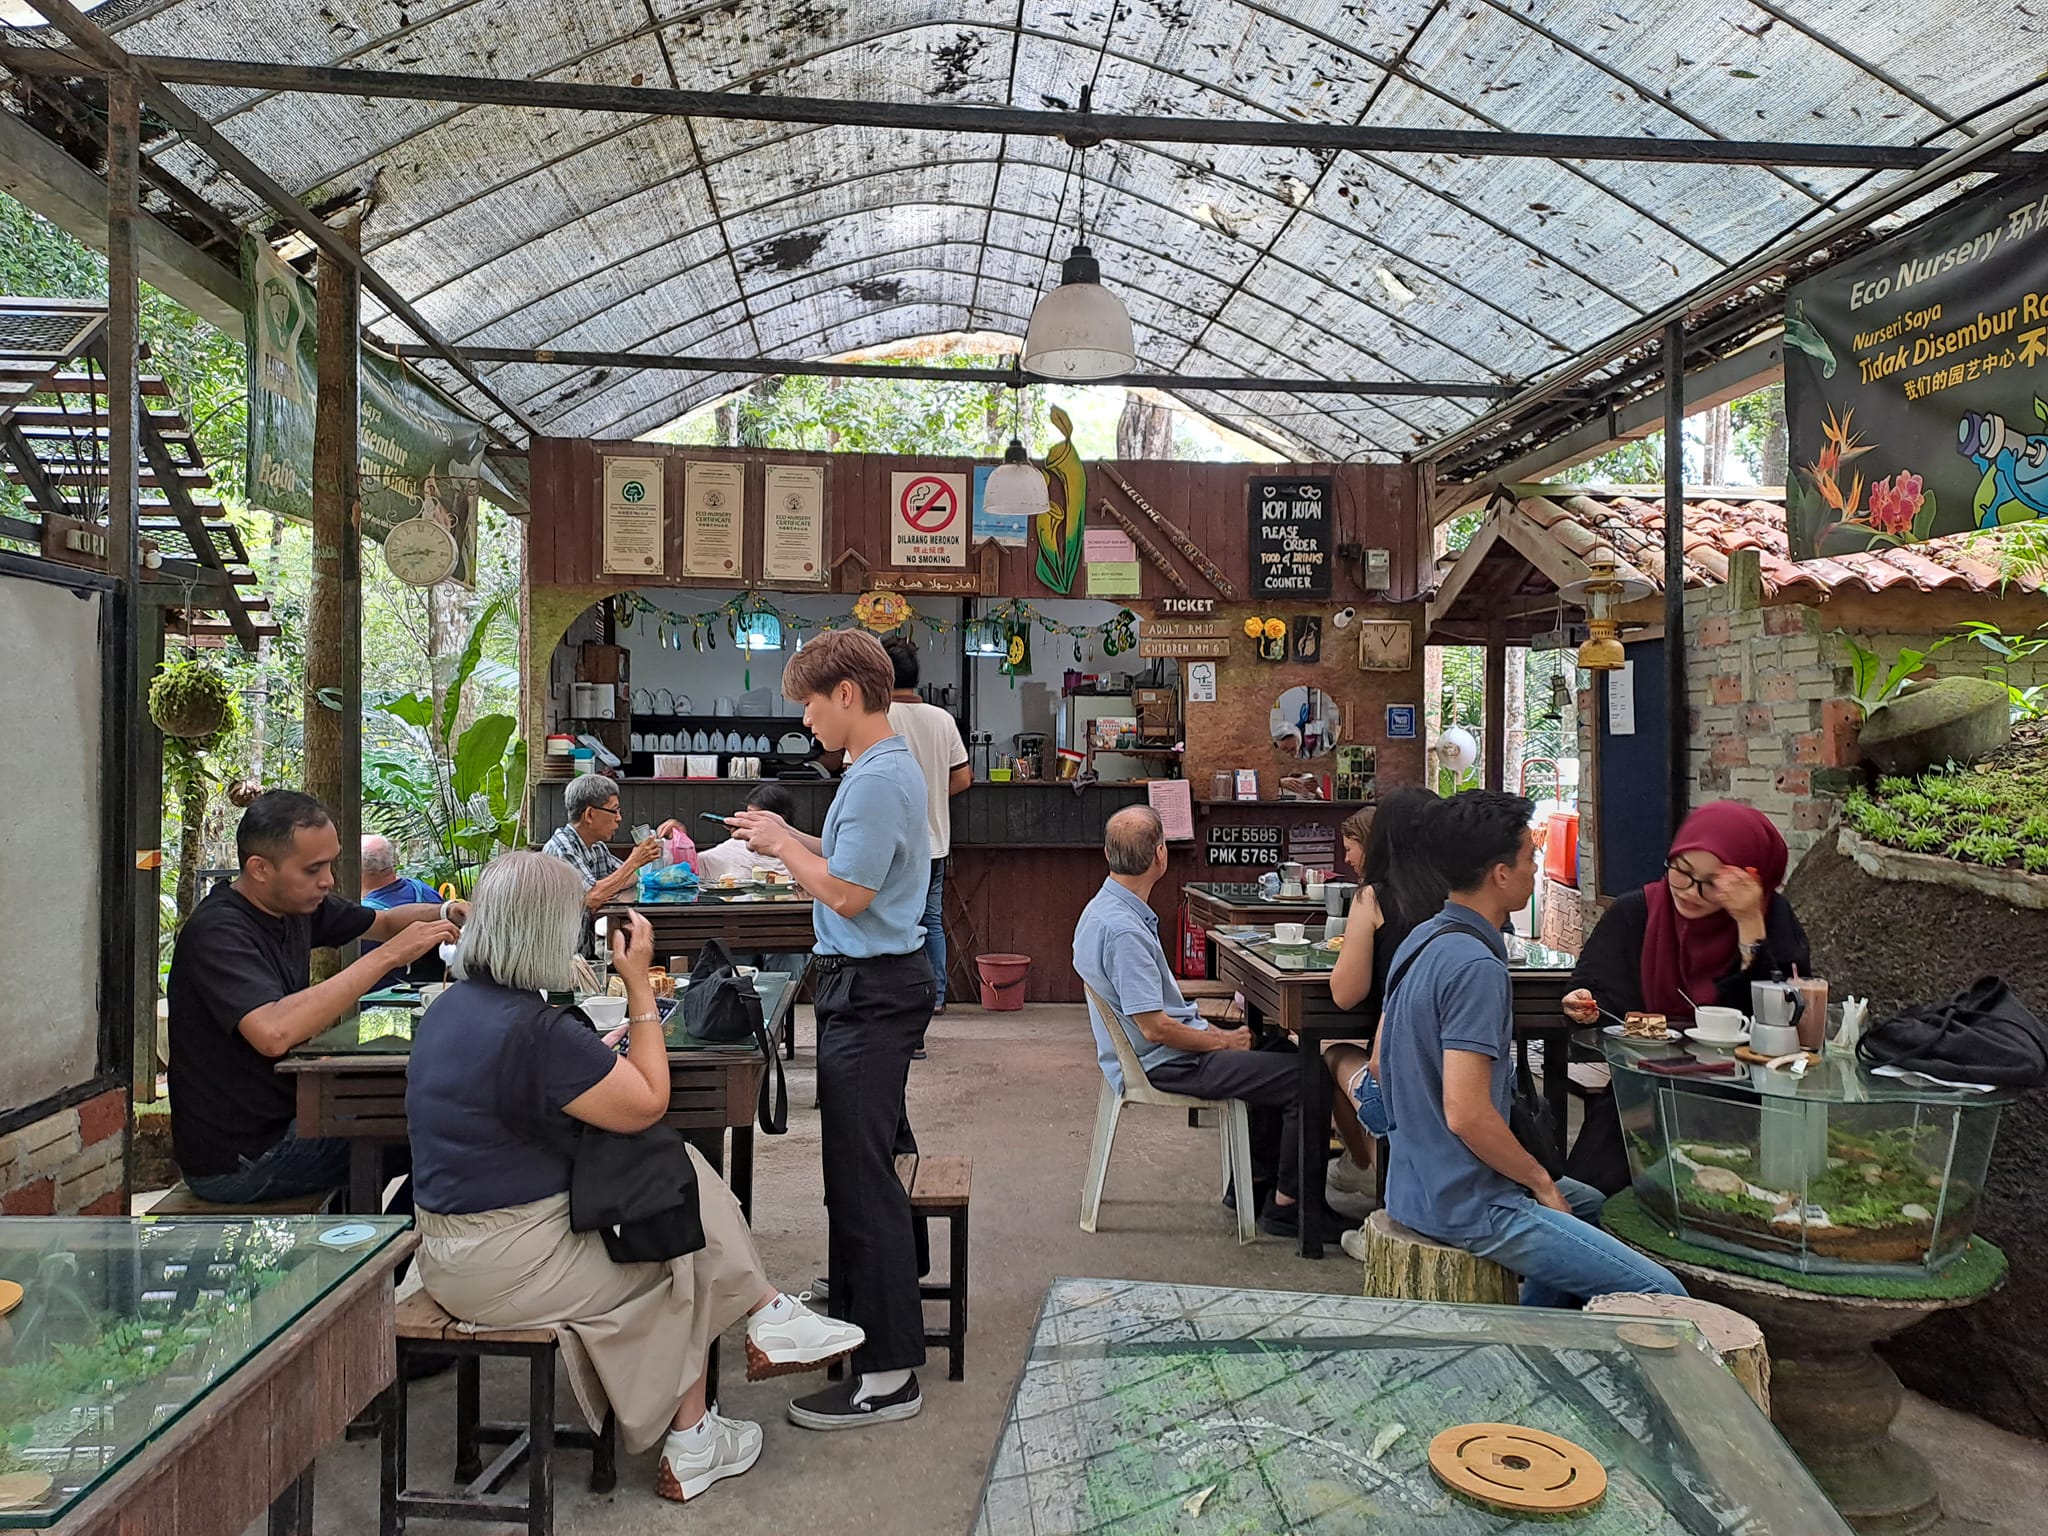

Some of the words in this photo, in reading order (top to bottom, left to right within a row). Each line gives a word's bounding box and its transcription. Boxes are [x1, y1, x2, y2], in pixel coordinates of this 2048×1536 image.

[1850, 277, 1891, 311] Eco
[1895, 227, 2002, 292] Nursery
[1852, 314, 1903, 352] Nurseri
[1904, 304, 1942, 331] Saya
[1858, 345, 1910, 385] Tidak
[1912, 307, 2017, 366] Disembur
[2018, 326, 2048, 368] 不
[360, 420, 408, 467] isembur
[1121, 480, 1161, 524] WELCOME
[1262, 501, 1287, 520] KOPI
[1292, 501, 1322, 520] HUTAN
[776, 520, 811, 528] CERTIFICATE
[1261, 525, 1299, 540] PLEASE
[897, 535, 928, 544] DILARANG
[930, 536, 960, 545] MEROKOK
[1283, 539, 1317, 551] ORDER
[906, 555, 917, 563] NO
[918, 555, 951, 564] SMOKING
[1260, 553, 1280, 565] FOOD
[1292, 552, 1324, 564] DRINKS
[1270, 564, 1283, 575] AT
[1291, 564, 1313, 575] THE
[1264, 576, 1312, 589] COUNTER
[1163, 599, 1214, 612] TICKET
[1149, 624, 1180, 635] ADULT
[1145, 643, 1190, 653] CHILDREN
[1197, 644, 1209, 653] RM
[1212, 827, 1240, 842] PCF
[1210, 848, 1237, 863] PMK
[1241, 848, 1278, 863] 5765
